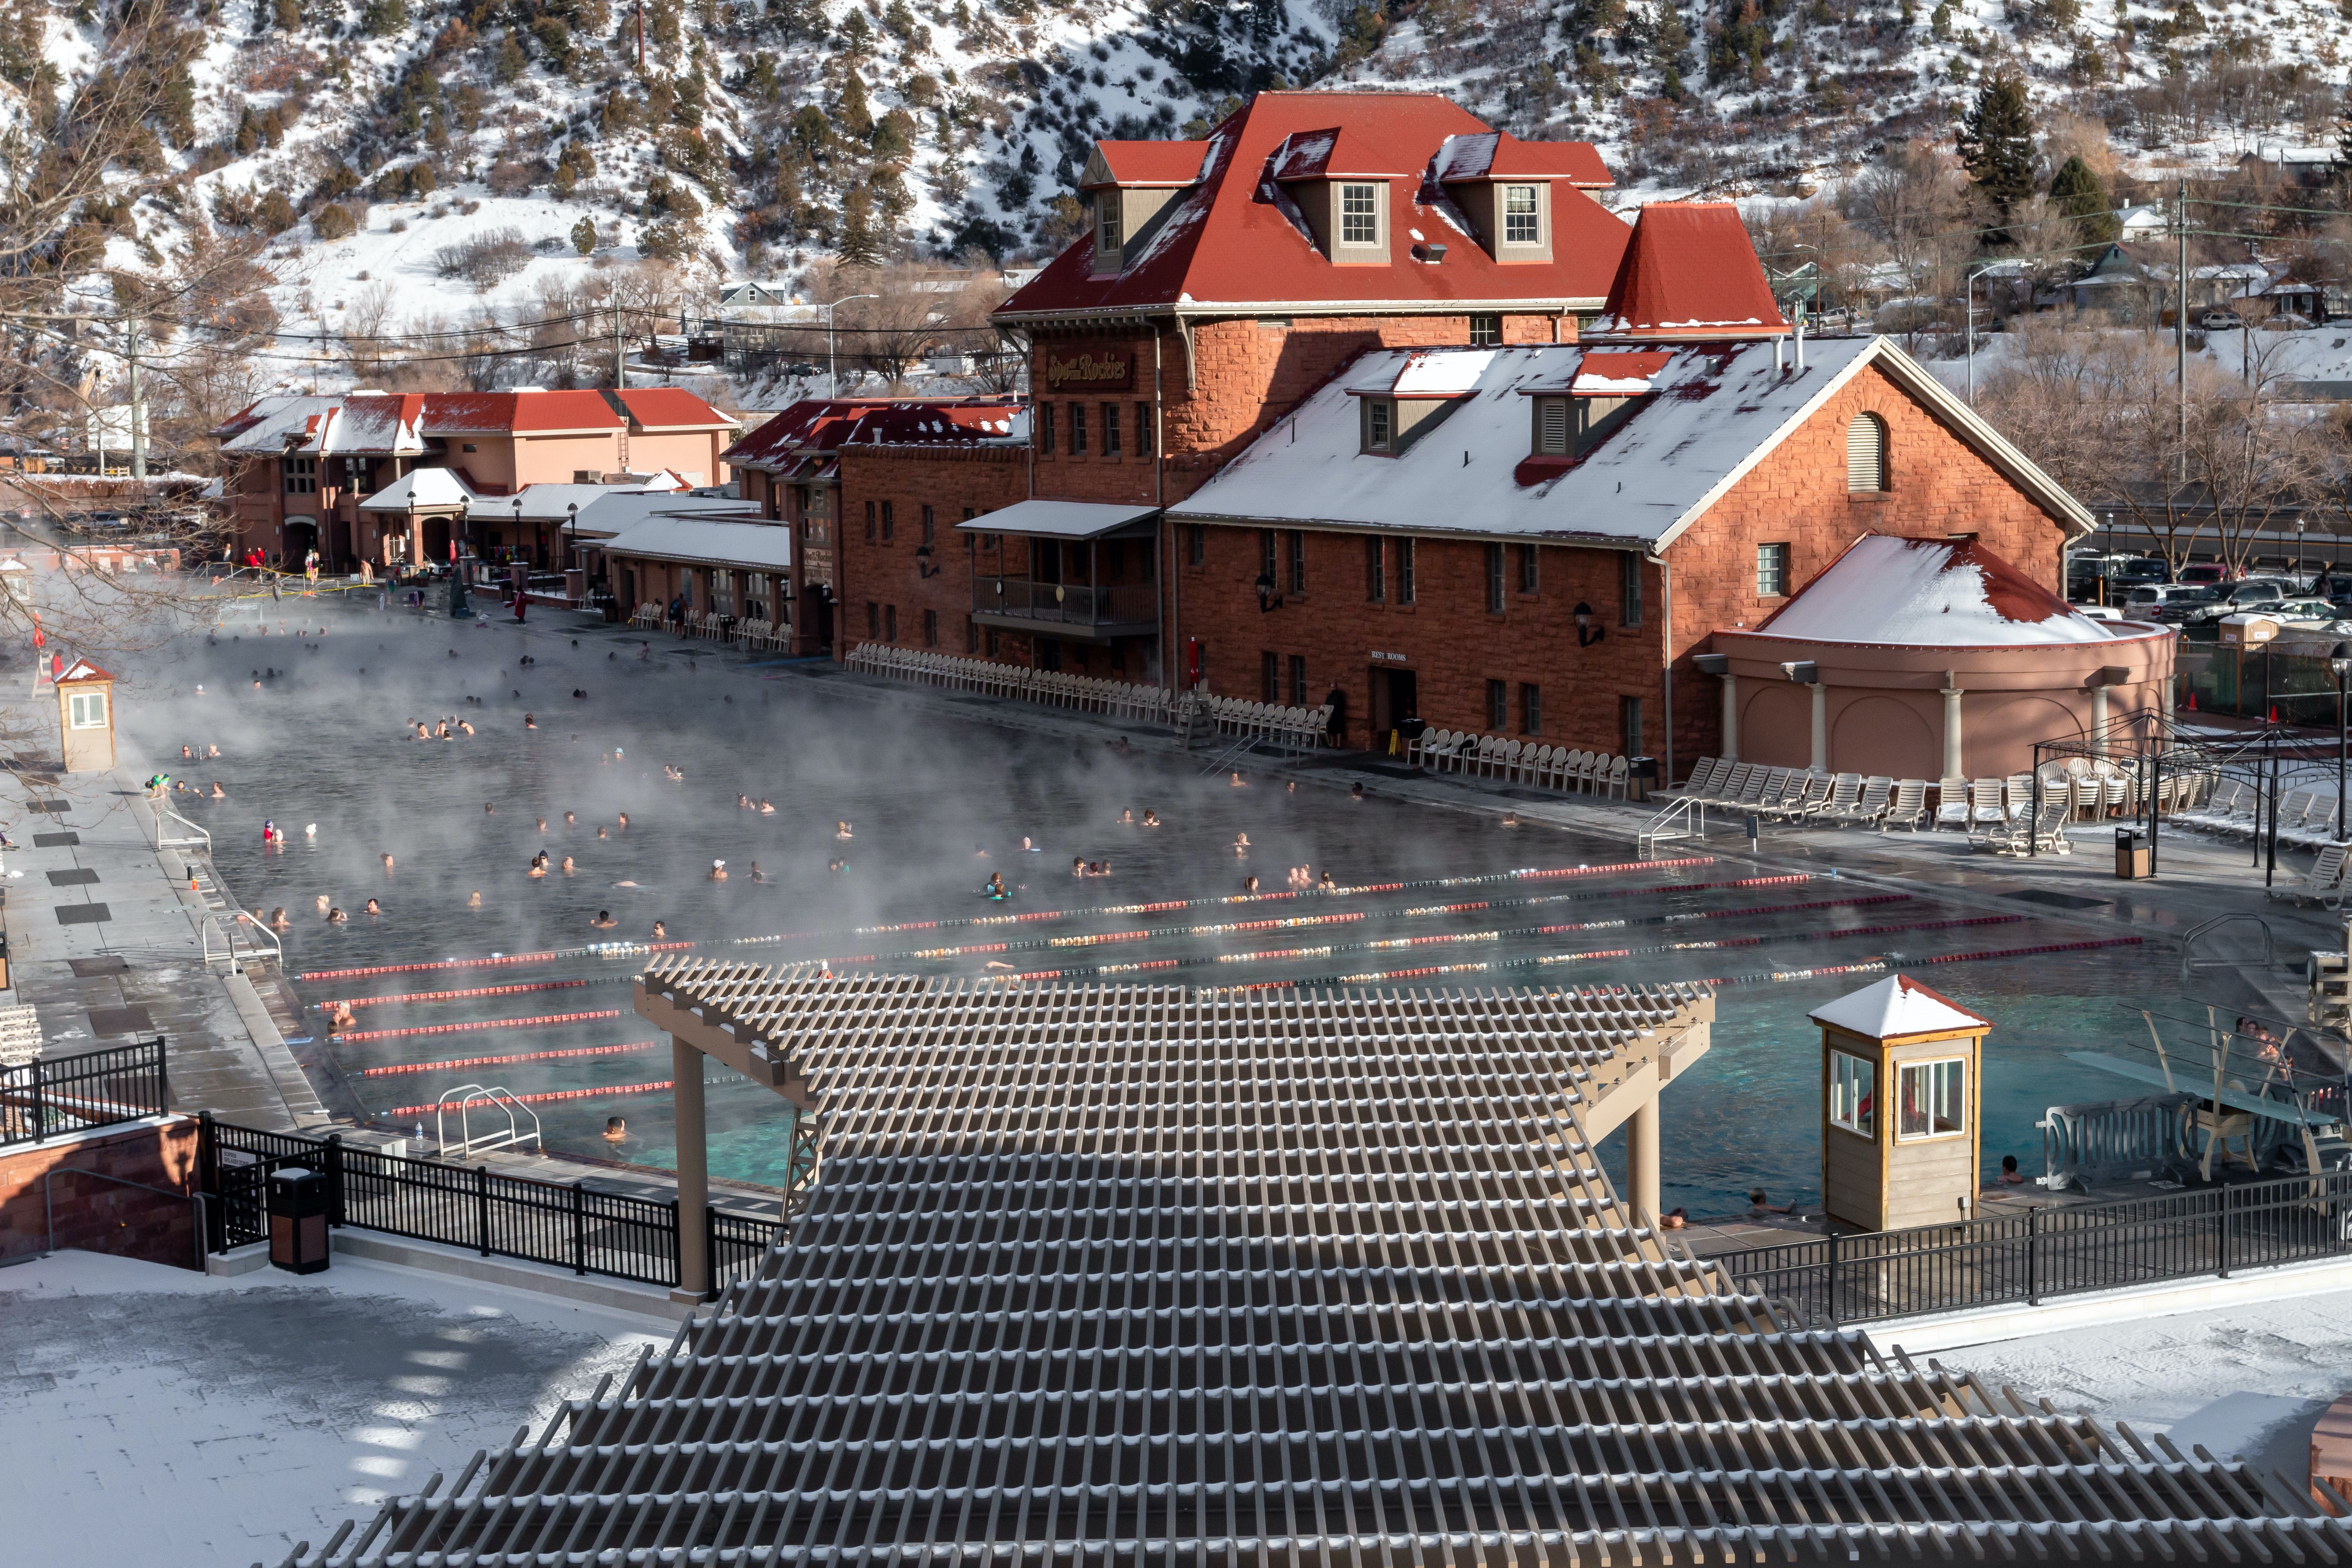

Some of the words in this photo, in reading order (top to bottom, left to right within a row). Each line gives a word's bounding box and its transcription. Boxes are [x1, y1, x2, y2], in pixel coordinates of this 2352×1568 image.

[1048, 355, 1070, 386] Spa
[1079, 352, 1125, 380] Rockies
[1387, 653, 1406, 661] ROOMS
